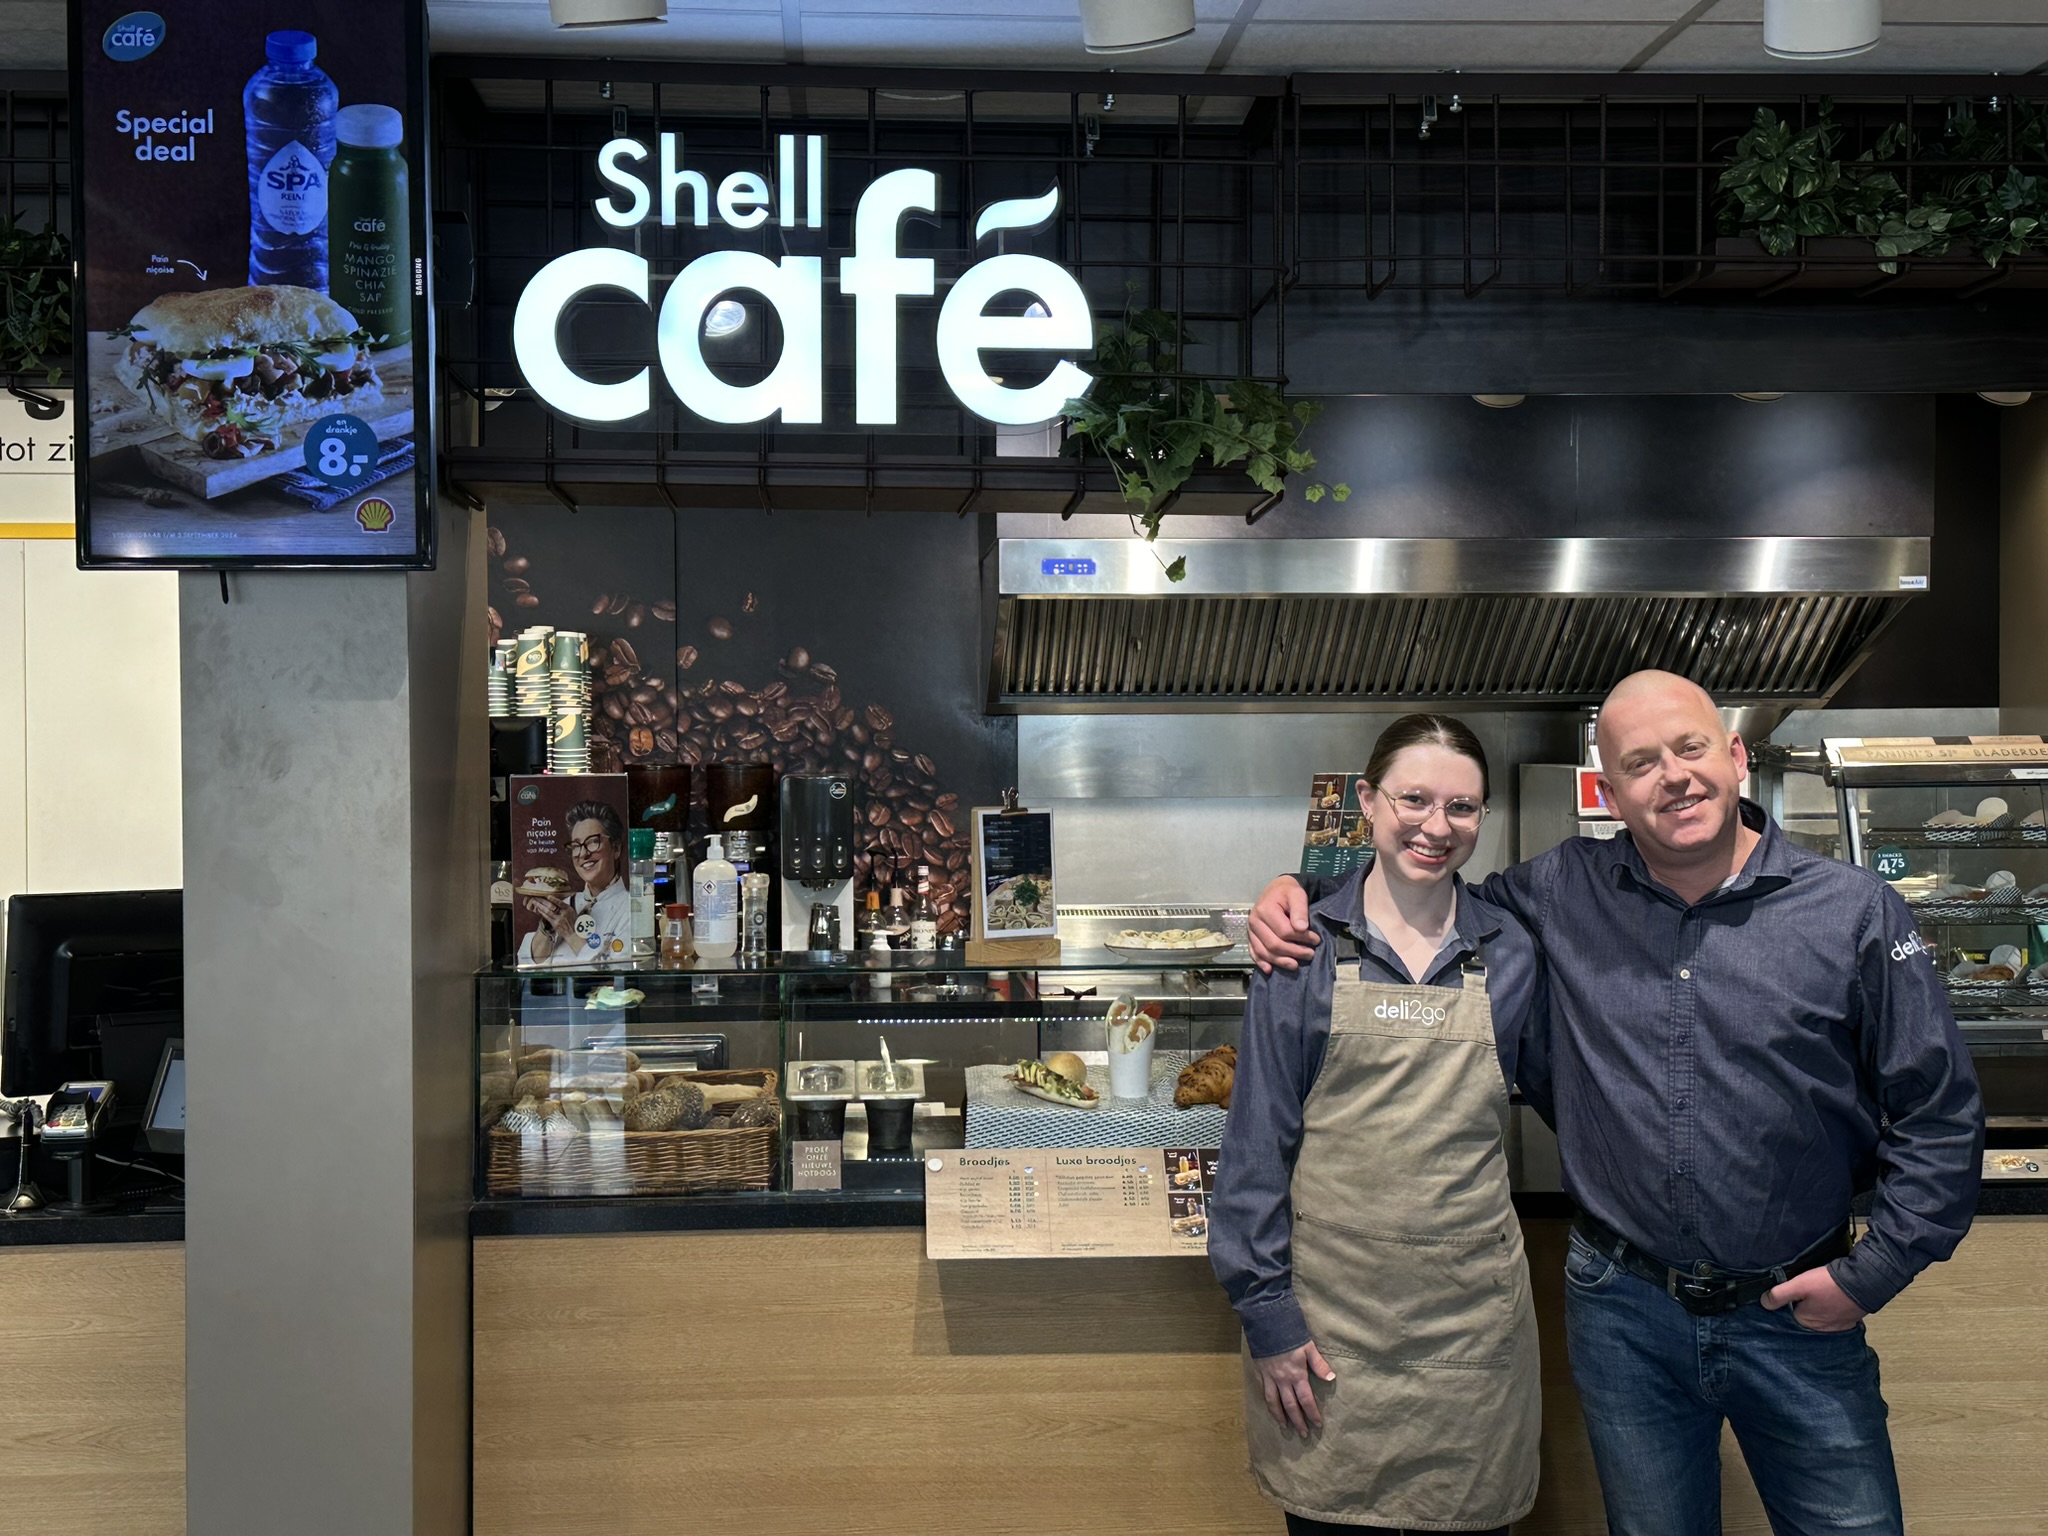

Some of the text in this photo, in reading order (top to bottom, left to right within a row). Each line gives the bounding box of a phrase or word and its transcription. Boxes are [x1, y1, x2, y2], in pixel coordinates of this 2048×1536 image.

[111, 27, 156, 47] café
[116, 108, 214, 140] Special
[135, 135, 195, 161] deal
[266, 171, 322, 191] SPA
[595, 132, 823, 229] Shell
[353, 218, 386, 233] café
[151, 254, 170, 263] Pain
[344, 253, 395, 266] MANGO
[145, 265, 175, 276] niçoise
[343, 264, 397, 278] SPINAZIE
[414, 257, 424, 297] SAMSUNG
[355, 280, 386, 290] CHIA
[359, 292, 382, 303] SAP
[513, 168, 1094, 425] café
[325, 425, 358, 436] drankje
[531, 817, 552, 827] Pain
[1877, 858, 1905, 874] 4.75
[1374, 998, 1446, 1026] deli2go
[959, 1156, 1010, 1168] Broodjes
[1056, 1153, 1137, 1167] Luxe broodjes
